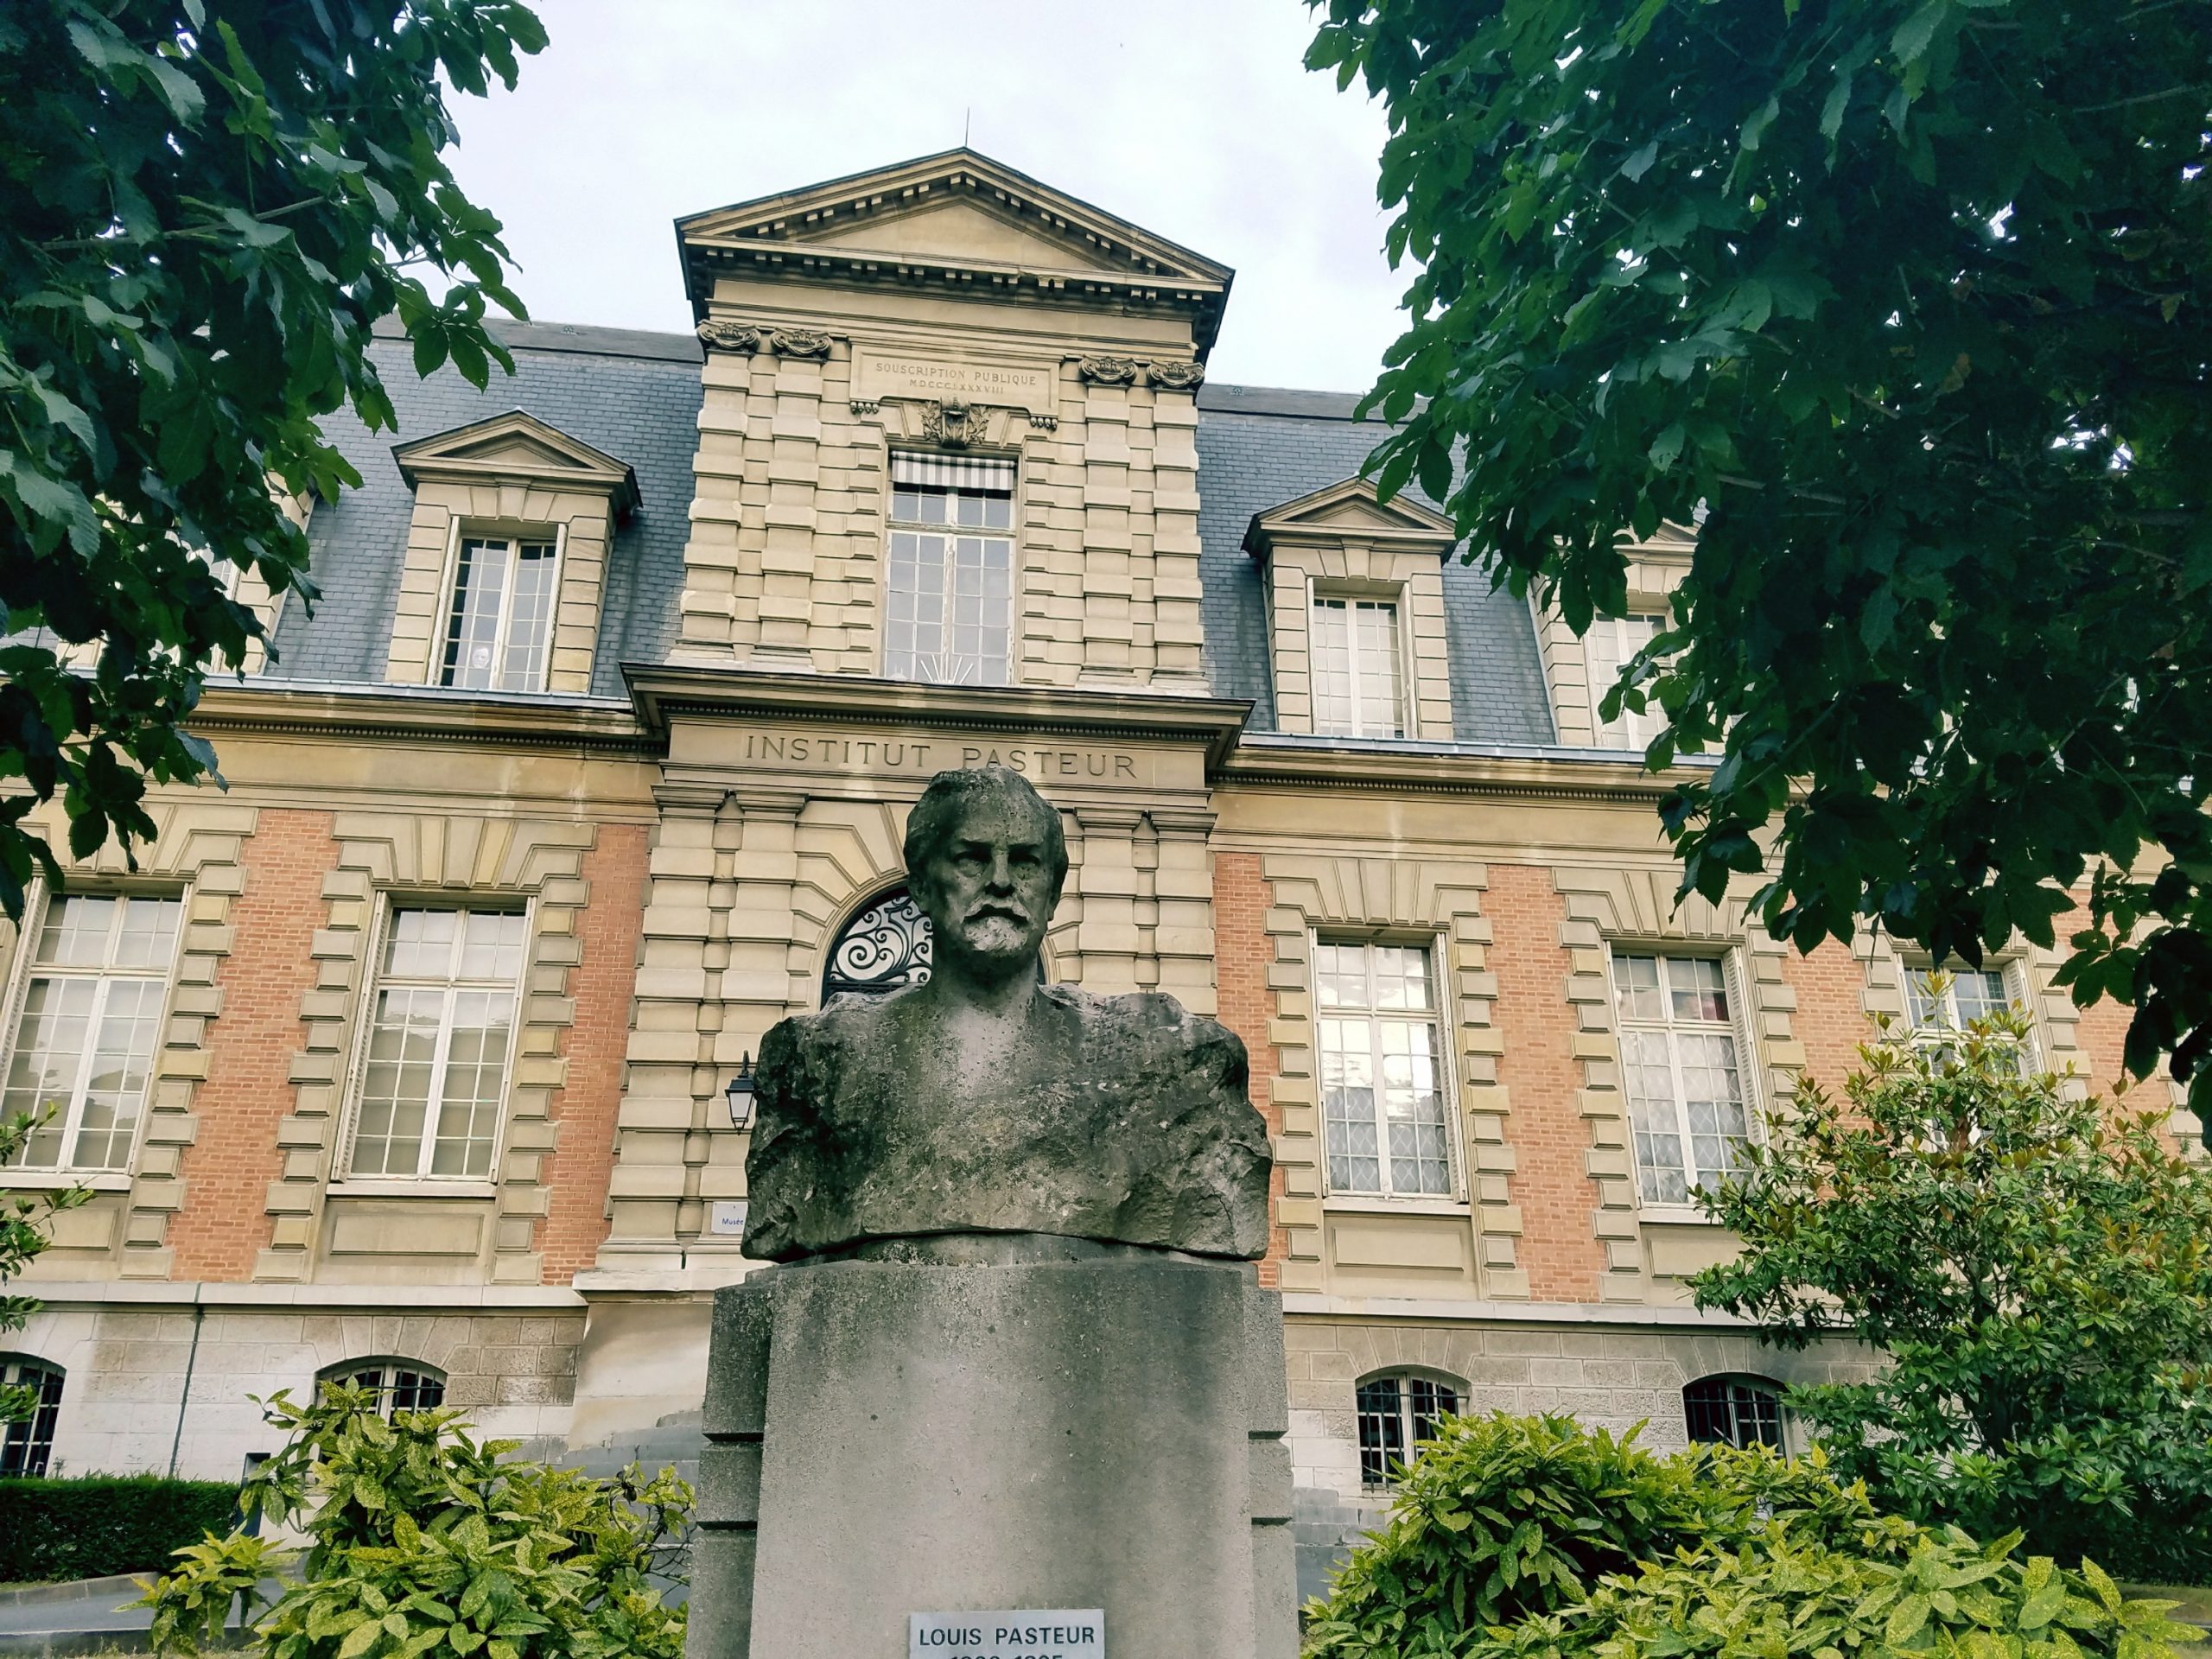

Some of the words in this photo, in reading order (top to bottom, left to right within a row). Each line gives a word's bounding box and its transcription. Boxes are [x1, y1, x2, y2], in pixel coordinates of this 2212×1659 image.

[875, 362, 966, 379] SOUSCRIPTION
[974, 371, 1037, 386] PUBLIQUE
[909, 378, 1004, 394] MDCCCLXXXVIII
[746, 735, 931, 768] INSTITUT
[962, 747, 1138, 779] PASTEUR
[919, 1628, 982, 1646] LOUIS
[995, 1626, 1095, 1645] PASTEUR
